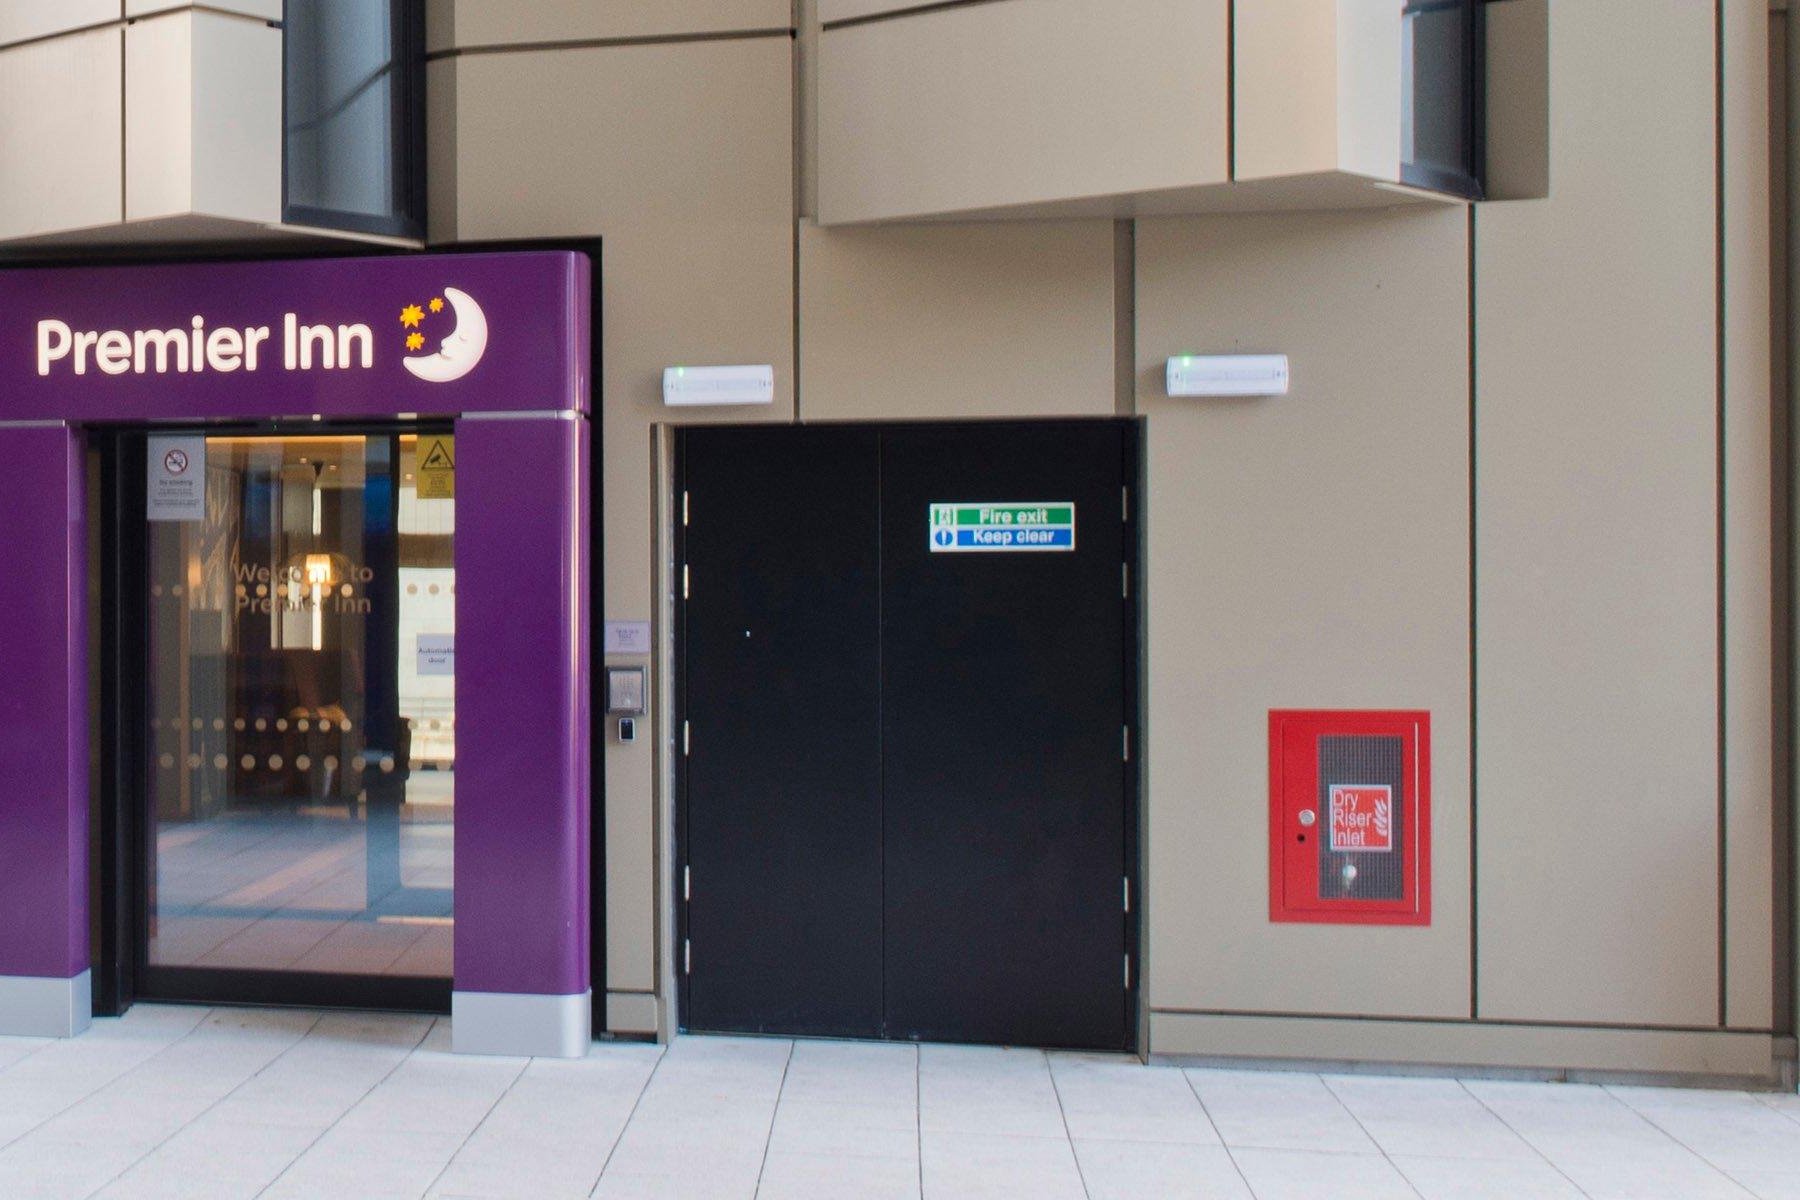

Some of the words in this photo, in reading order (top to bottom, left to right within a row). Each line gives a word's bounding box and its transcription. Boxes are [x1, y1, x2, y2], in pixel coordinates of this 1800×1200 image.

[37, 314, 270, 376] Premier
[284, 312, 373, 370] Inn
[979, 508, 1013, 524] Fire
[1016, 508, 1048, 524] exit
[973, 528, 1013, 546] Keep
[1016, 528, 1055, 543] clear
[234, 563, 342, 583] Wecom
[350, 564, 374, 583] to
[236, 594, 331, 614] Prer
[334, 593, 372, 614] Inn
[1333, 789, 1359, 811] Dry
[1333, 808, 1372, 828] Riser
[1333, 827, 1365, 846] Inlet
